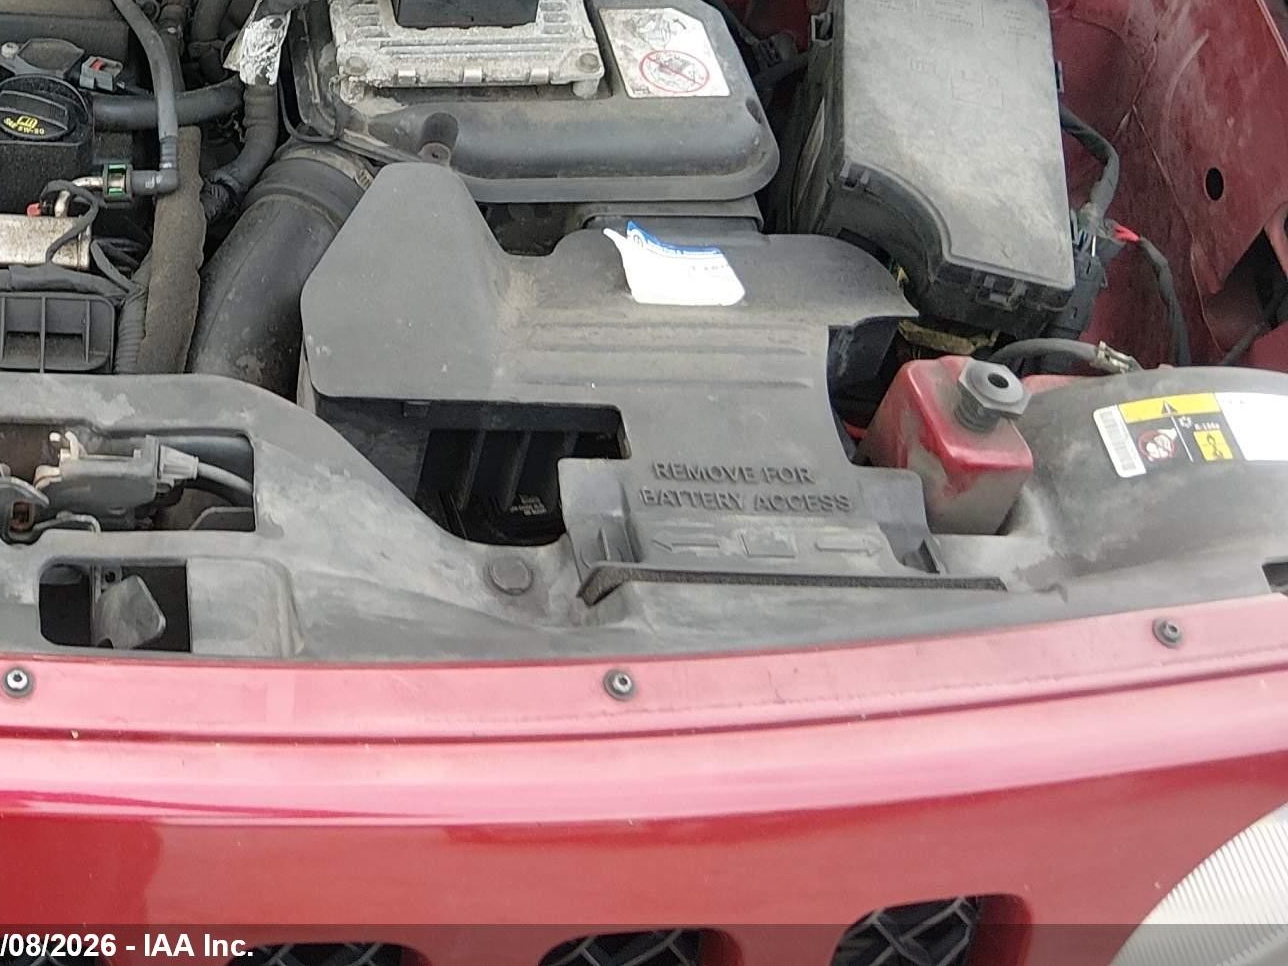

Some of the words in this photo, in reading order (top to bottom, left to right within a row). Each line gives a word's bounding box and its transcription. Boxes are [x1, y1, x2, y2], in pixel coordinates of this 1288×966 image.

[652, 461, 754, 483] REMOVE
[762, 466, 815, 485] FOR
[640, 488, 743, 511] BATTERY
[754, 493, 851, 513] ACCESS
